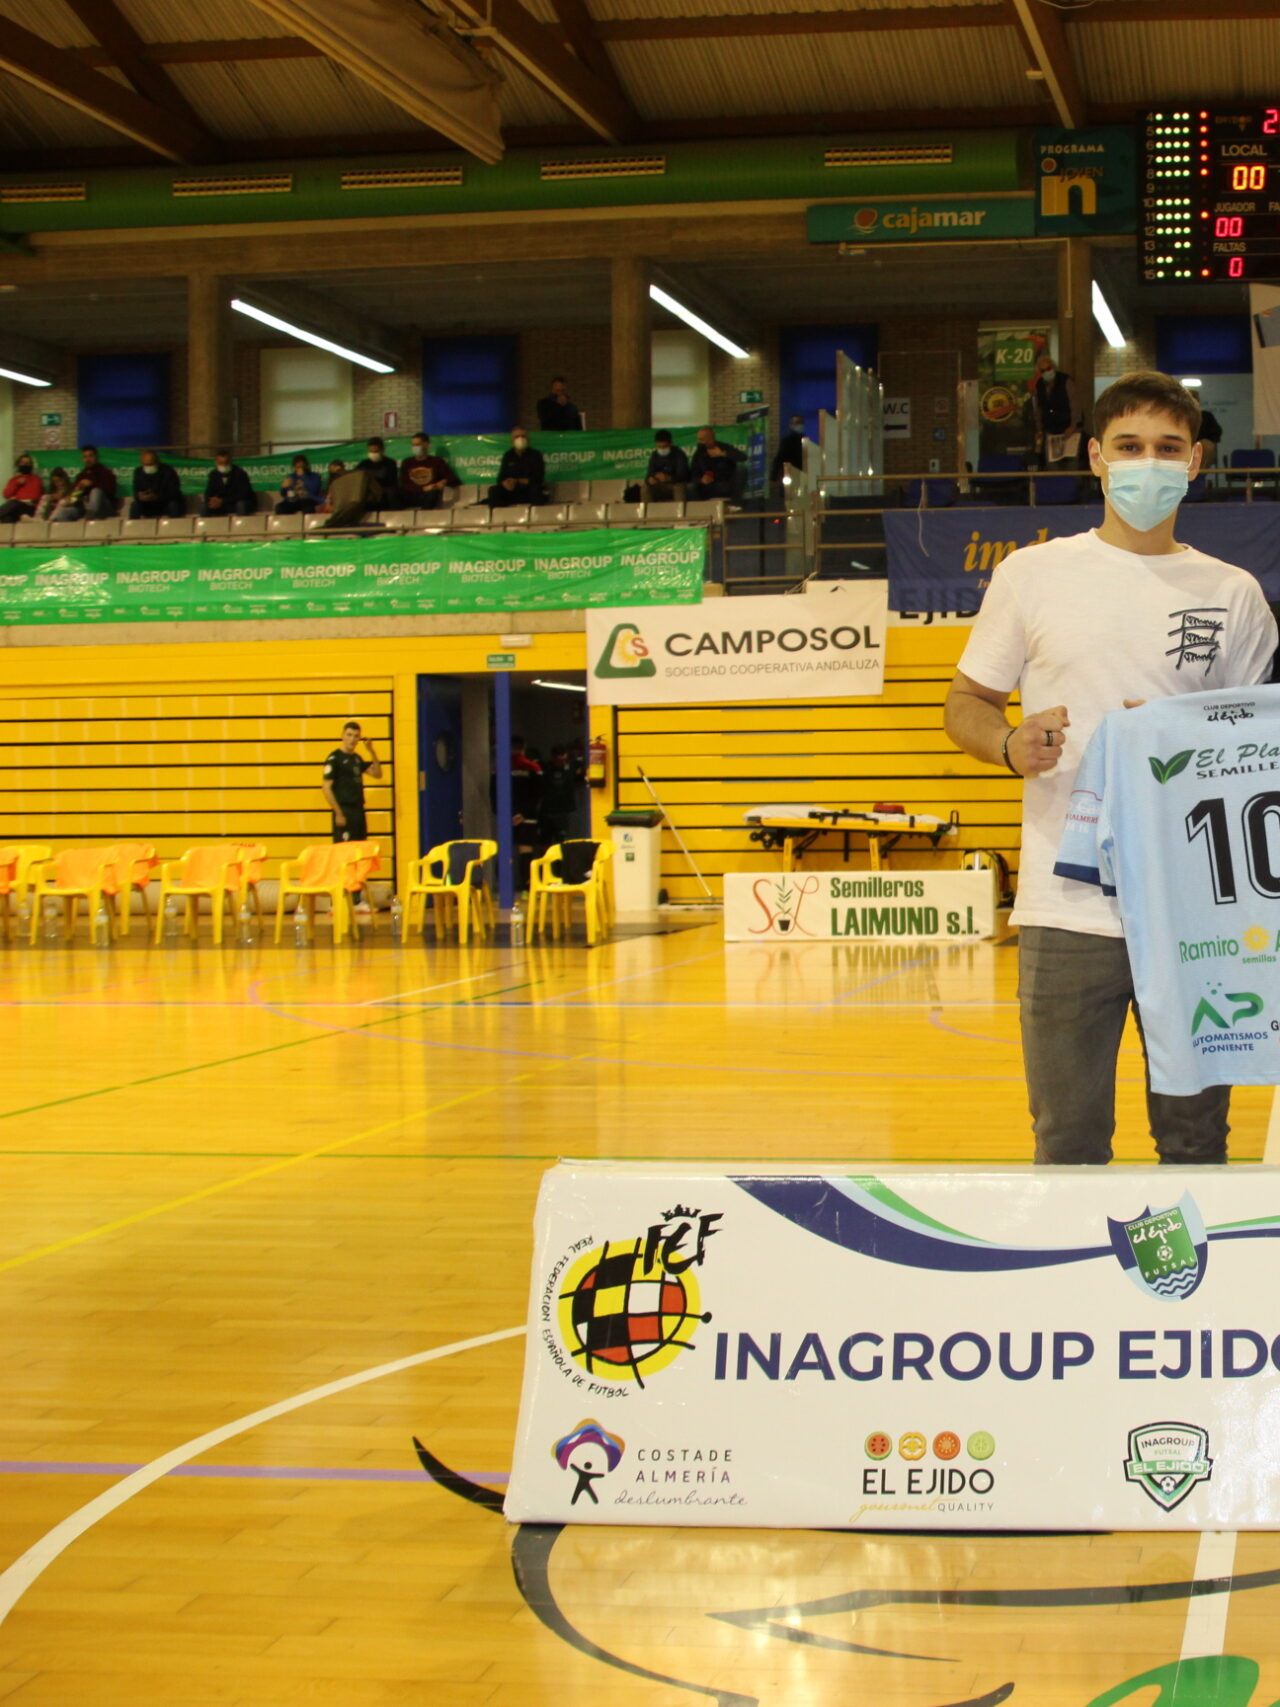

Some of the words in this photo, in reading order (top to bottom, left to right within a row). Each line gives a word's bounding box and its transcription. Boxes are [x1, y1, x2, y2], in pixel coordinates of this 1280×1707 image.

[1040, 144, 1104, 154] PROGRAMA
[1221, 144, 1268, 157] LOCAL
[1232, 165, 1265, 191] 00
[1214, 202, 1256, 213] JUGADOR
[882, 206, 987, 234] cajamar
[1215, 216, 1243, 237] 00
[1213, 241, 1247, 253] FALTAS
[1229, 256, 1243, 278] 0
[995, 348, 1034, 364] K-20
[449, 559, 526, 575] INAGROUP
[534, 556, 613, 572] INAGROUP
[620, 551, 700, 569] INAGROUP
[116, 569, 190, 584] INAGROUP
[198, 567, 273, 582] INAGROUP
[281, 565, 356, 580] INAGROUP
[364, 562, 441, 579] INAGROUP
[665, 625, 880, 657] CAMPOSOL
[665, 666, 727, 678] SOCIEDAD
[730, 661, 814, 676] COOPERATIVA
[816, 658, 880, 672] ANDALUZA
[1195, 746, 1225, 769] El
[830, 877, 924, 898] Semilleros
[831, 907, 938, 936] LAIMUND
[946, 906, 979, 935] s.l.
[1178, 935, 1240, 964] Ramiro
[1241, 954, 1277, 964] semillas
[1201, 1043, 1254, 1055] PONIENTE
[1144, 1256, 1195, 1278] FUTSAL
[715, 1330, 1095, 1381] INAGROUP
[571, 1374, 584, 1388] DE
[1141, 1436, 1195, 1448] INAGROUP
[1133, 1463, 1153, 1473] EL
[1156, 1461, 1204, 1472] EJIDO
[635, 1468, 731, 1483] ALMERÍA
[862, 1468, 896, 1495] EL
[907, 1468, 995, 1495] EJIDO
[614, 1489, 748, 1506] deslumbrante
[937, 1502, 995, 1512] QUALITY
